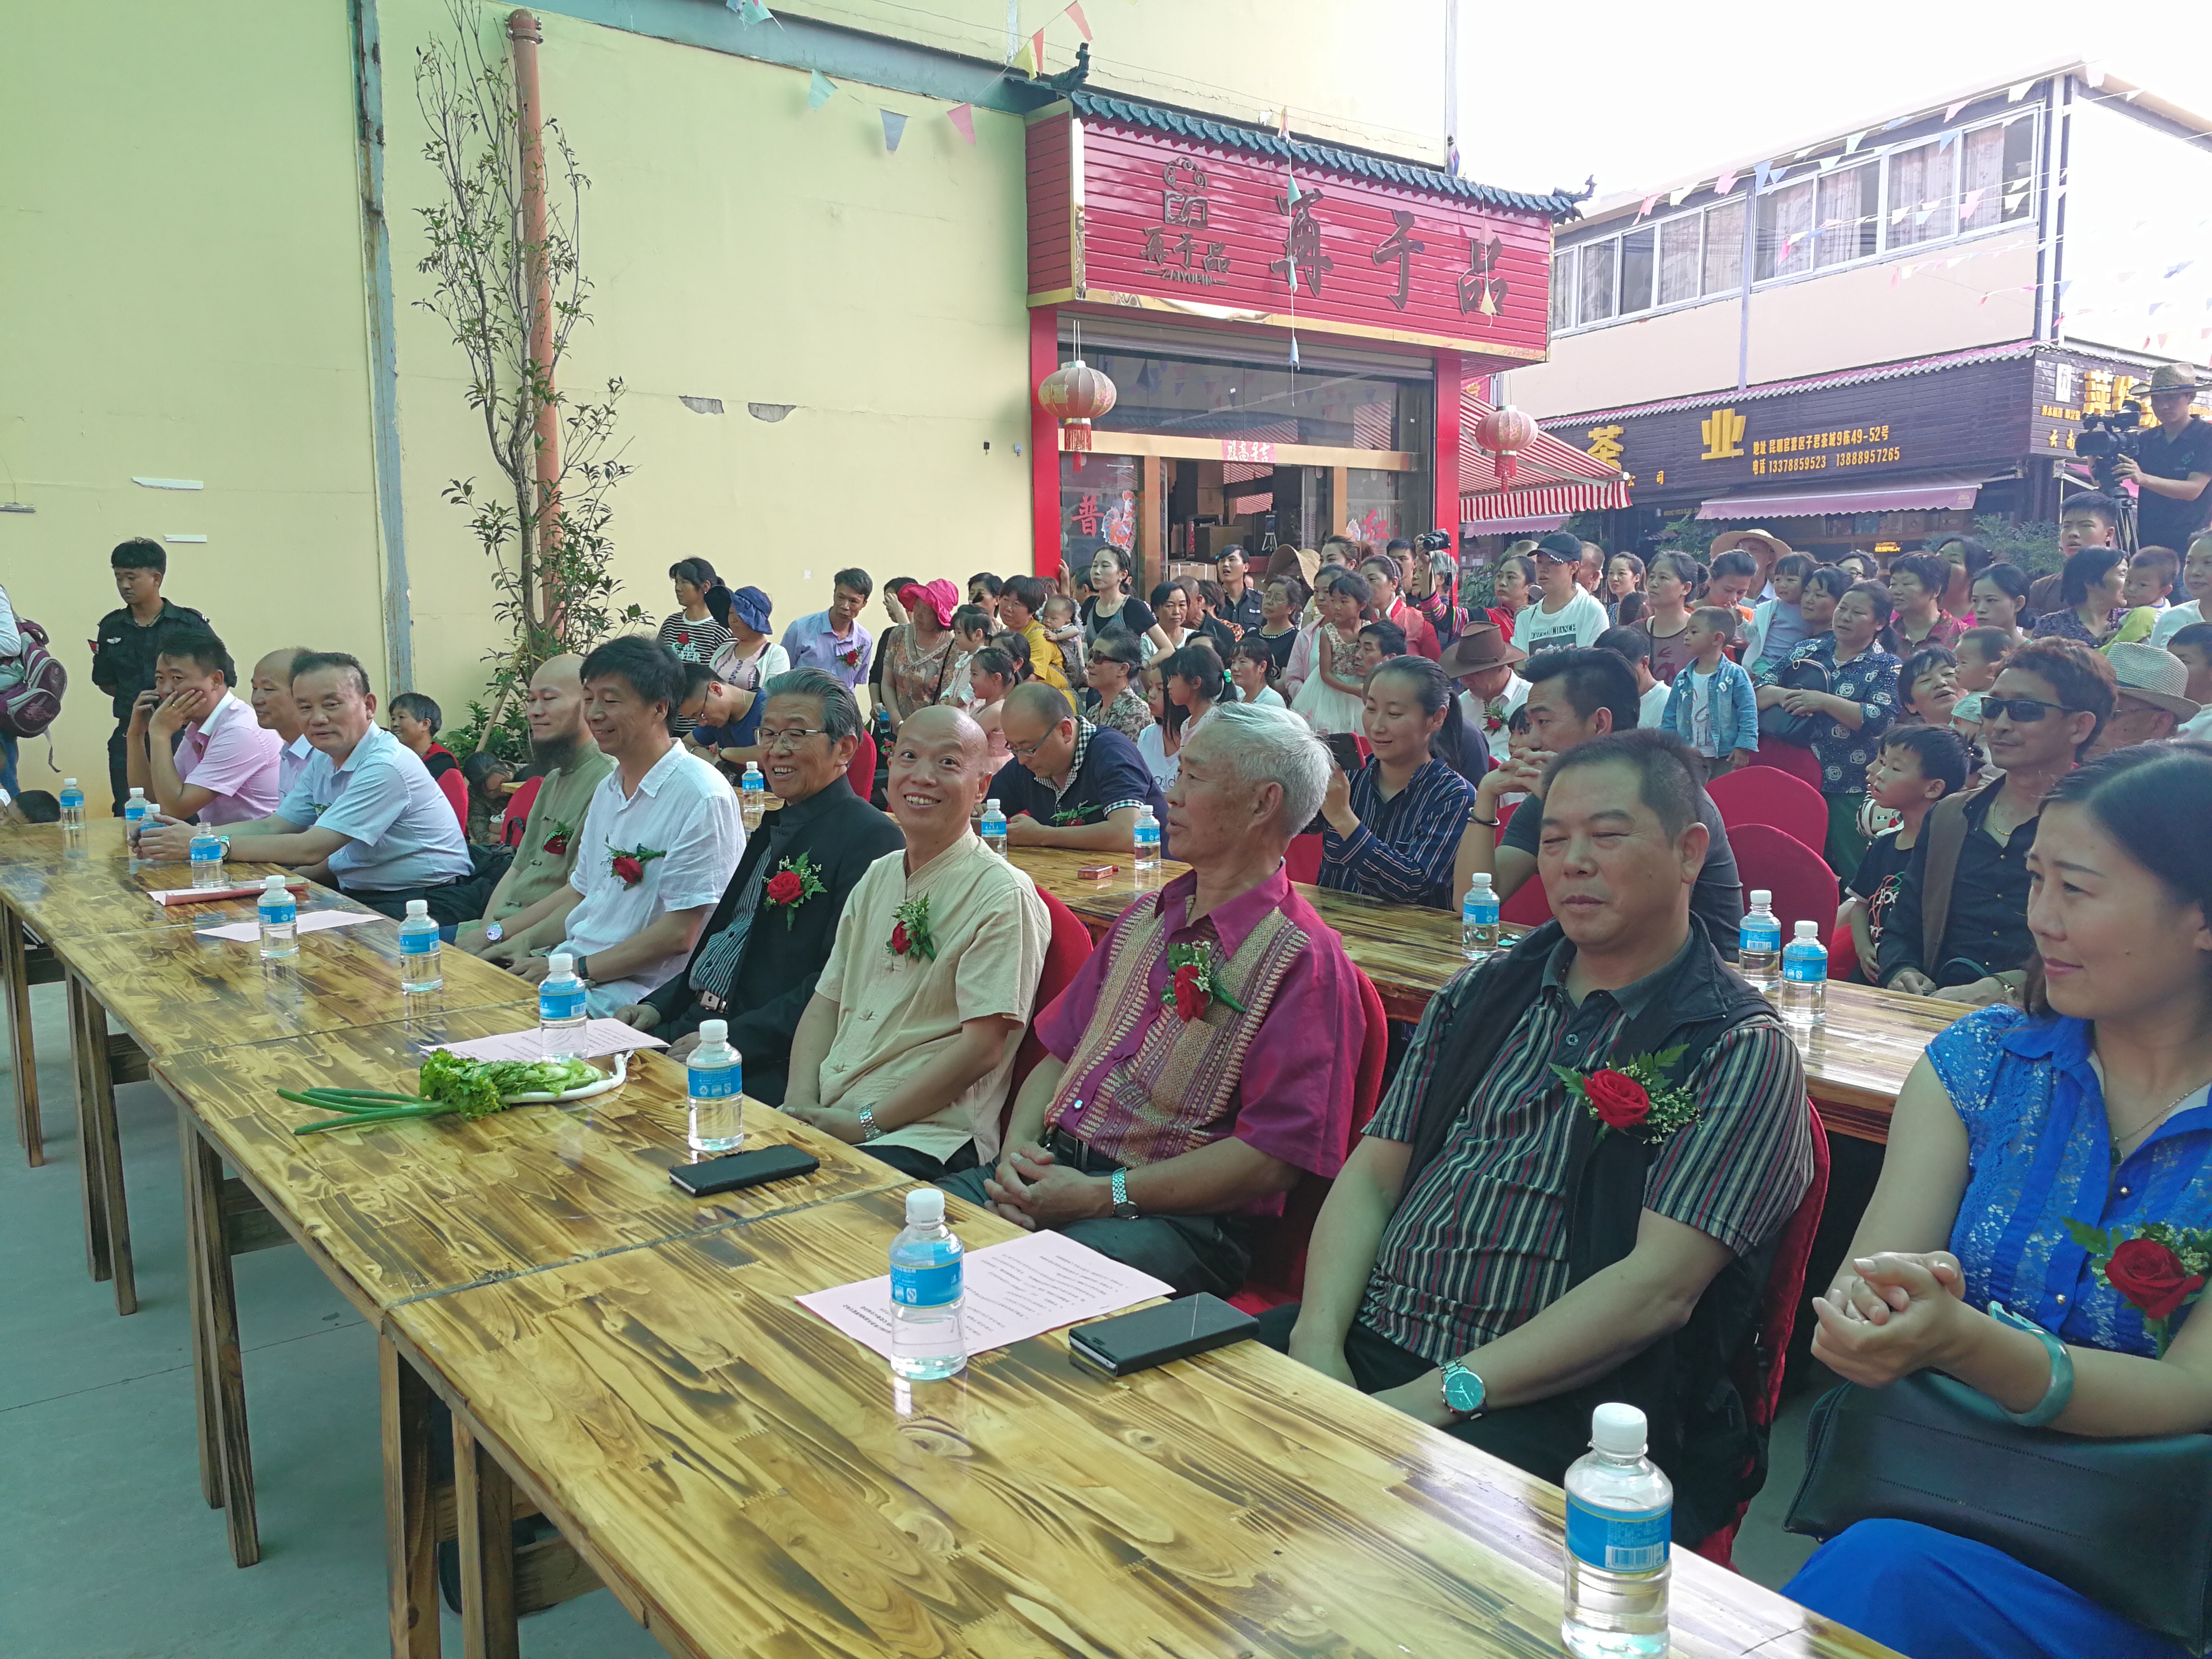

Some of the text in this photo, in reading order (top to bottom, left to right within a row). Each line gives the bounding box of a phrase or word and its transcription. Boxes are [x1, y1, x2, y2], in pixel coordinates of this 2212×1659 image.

[1752, 447, 1900, 475] 电话 13378859523 13888957265
[1753, 440, 1767, 455] 地址
[1070, 493, 1105, 538] 普
[1363, 508, 1390, 544] 红
[1551, 623, 1576, 635] CHANCE
